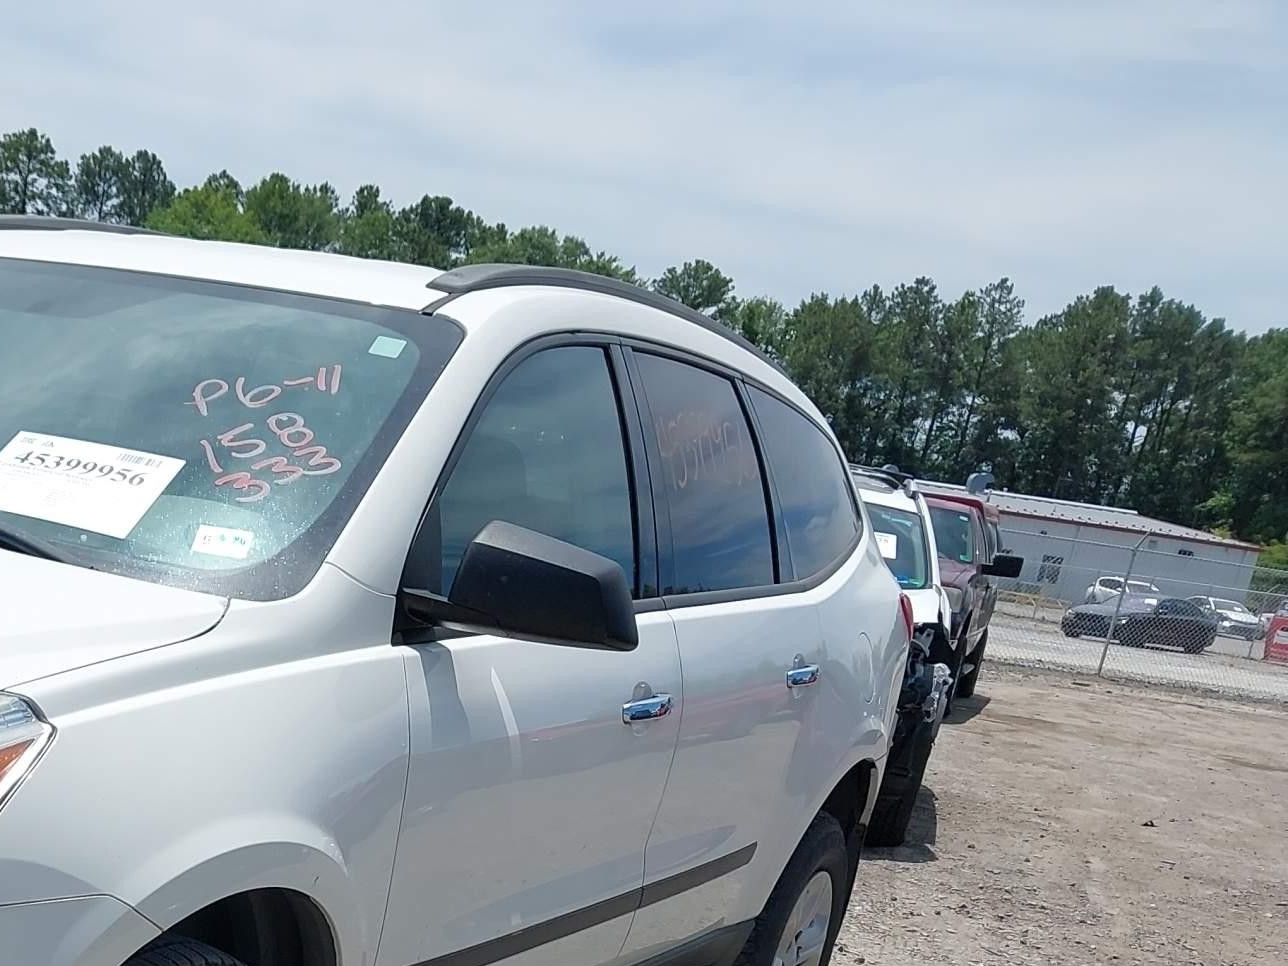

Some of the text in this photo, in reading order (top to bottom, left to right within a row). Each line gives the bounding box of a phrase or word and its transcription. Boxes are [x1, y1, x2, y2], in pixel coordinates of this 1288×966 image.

[192, 364, 342, 417] P6-11
[14, 450, 150, 487] 45399956
[200, 412, 314, 473] 158
[215, 445, 342, 503] 333
